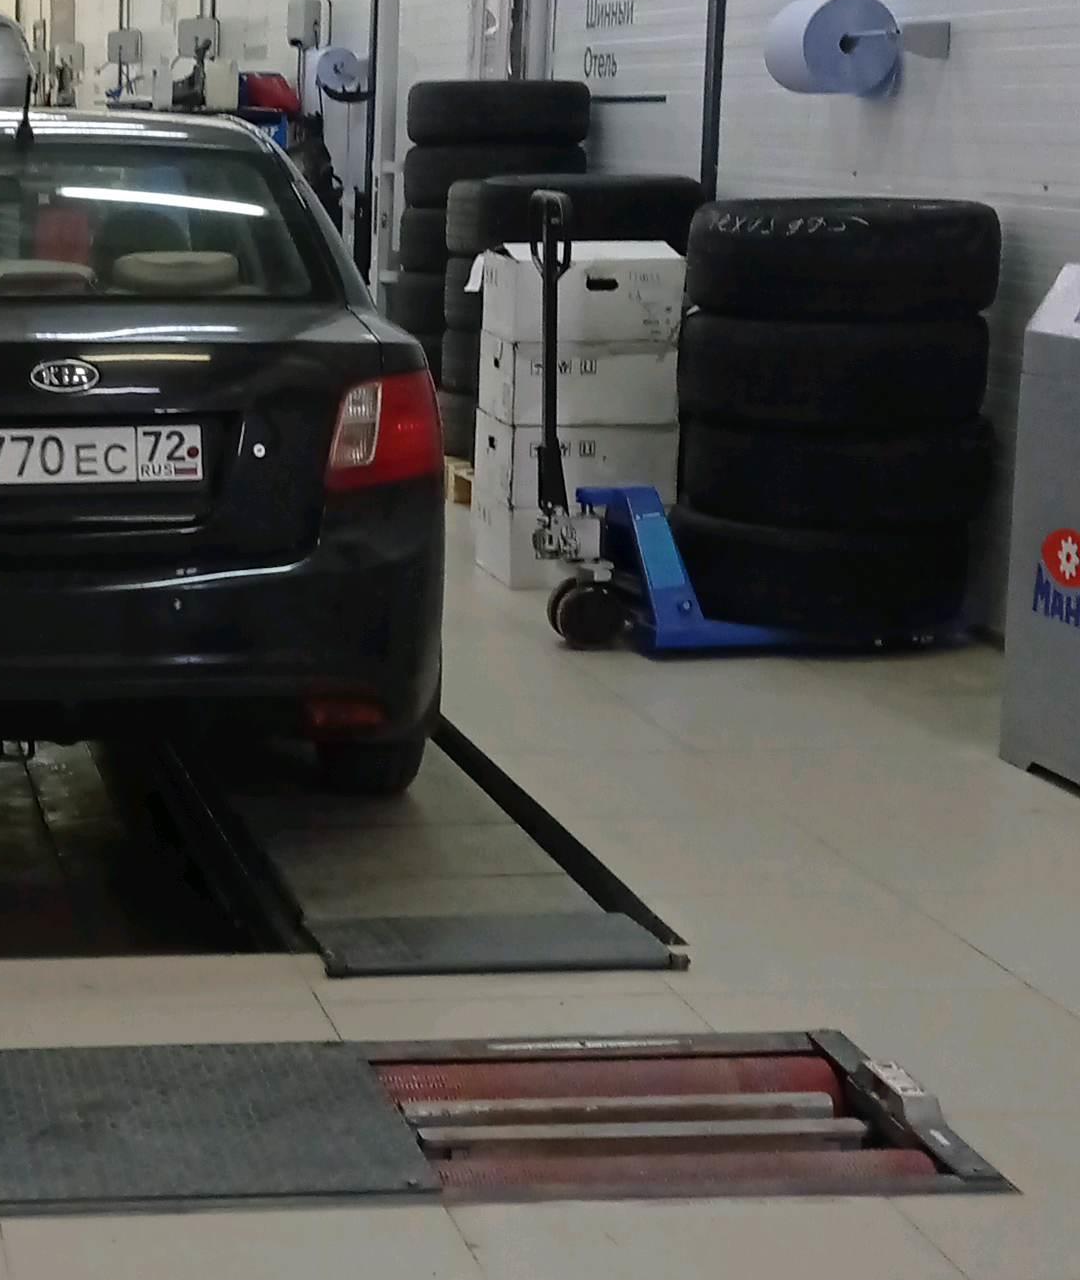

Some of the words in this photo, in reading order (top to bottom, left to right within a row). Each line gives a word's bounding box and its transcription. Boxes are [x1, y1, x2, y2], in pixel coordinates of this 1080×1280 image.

[583, 46, 618, 79] Отель
[142, 429, 187, 462] 72
[140, 463, 174, 477] RUS
